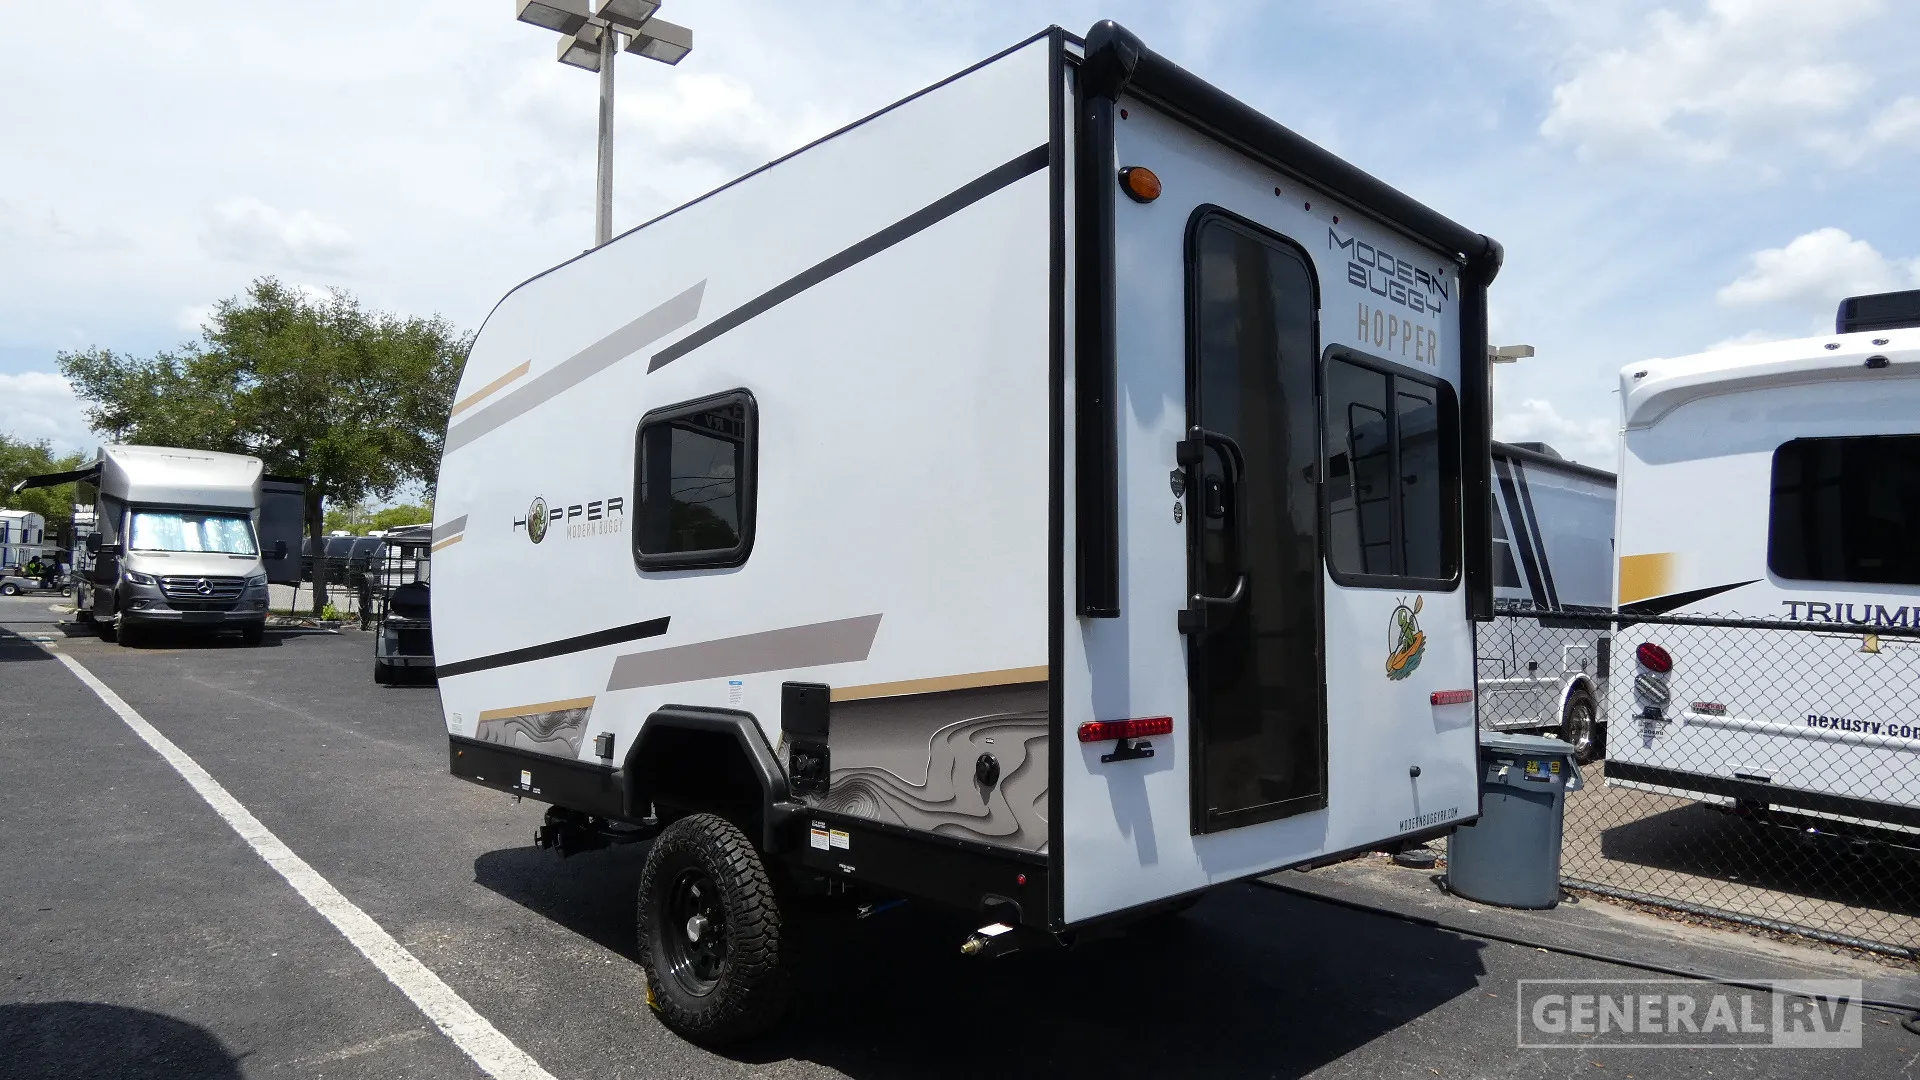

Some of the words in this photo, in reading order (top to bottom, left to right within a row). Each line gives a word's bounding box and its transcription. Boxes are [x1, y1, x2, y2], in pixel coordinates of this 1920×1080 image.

[1328, 226, 1449, 301] MODERN
[1347, 261, 1442, 319] BUGGY
[1357, 302, 1437, 367] HOPPER
[566, 522, 597, 540] MODERN
